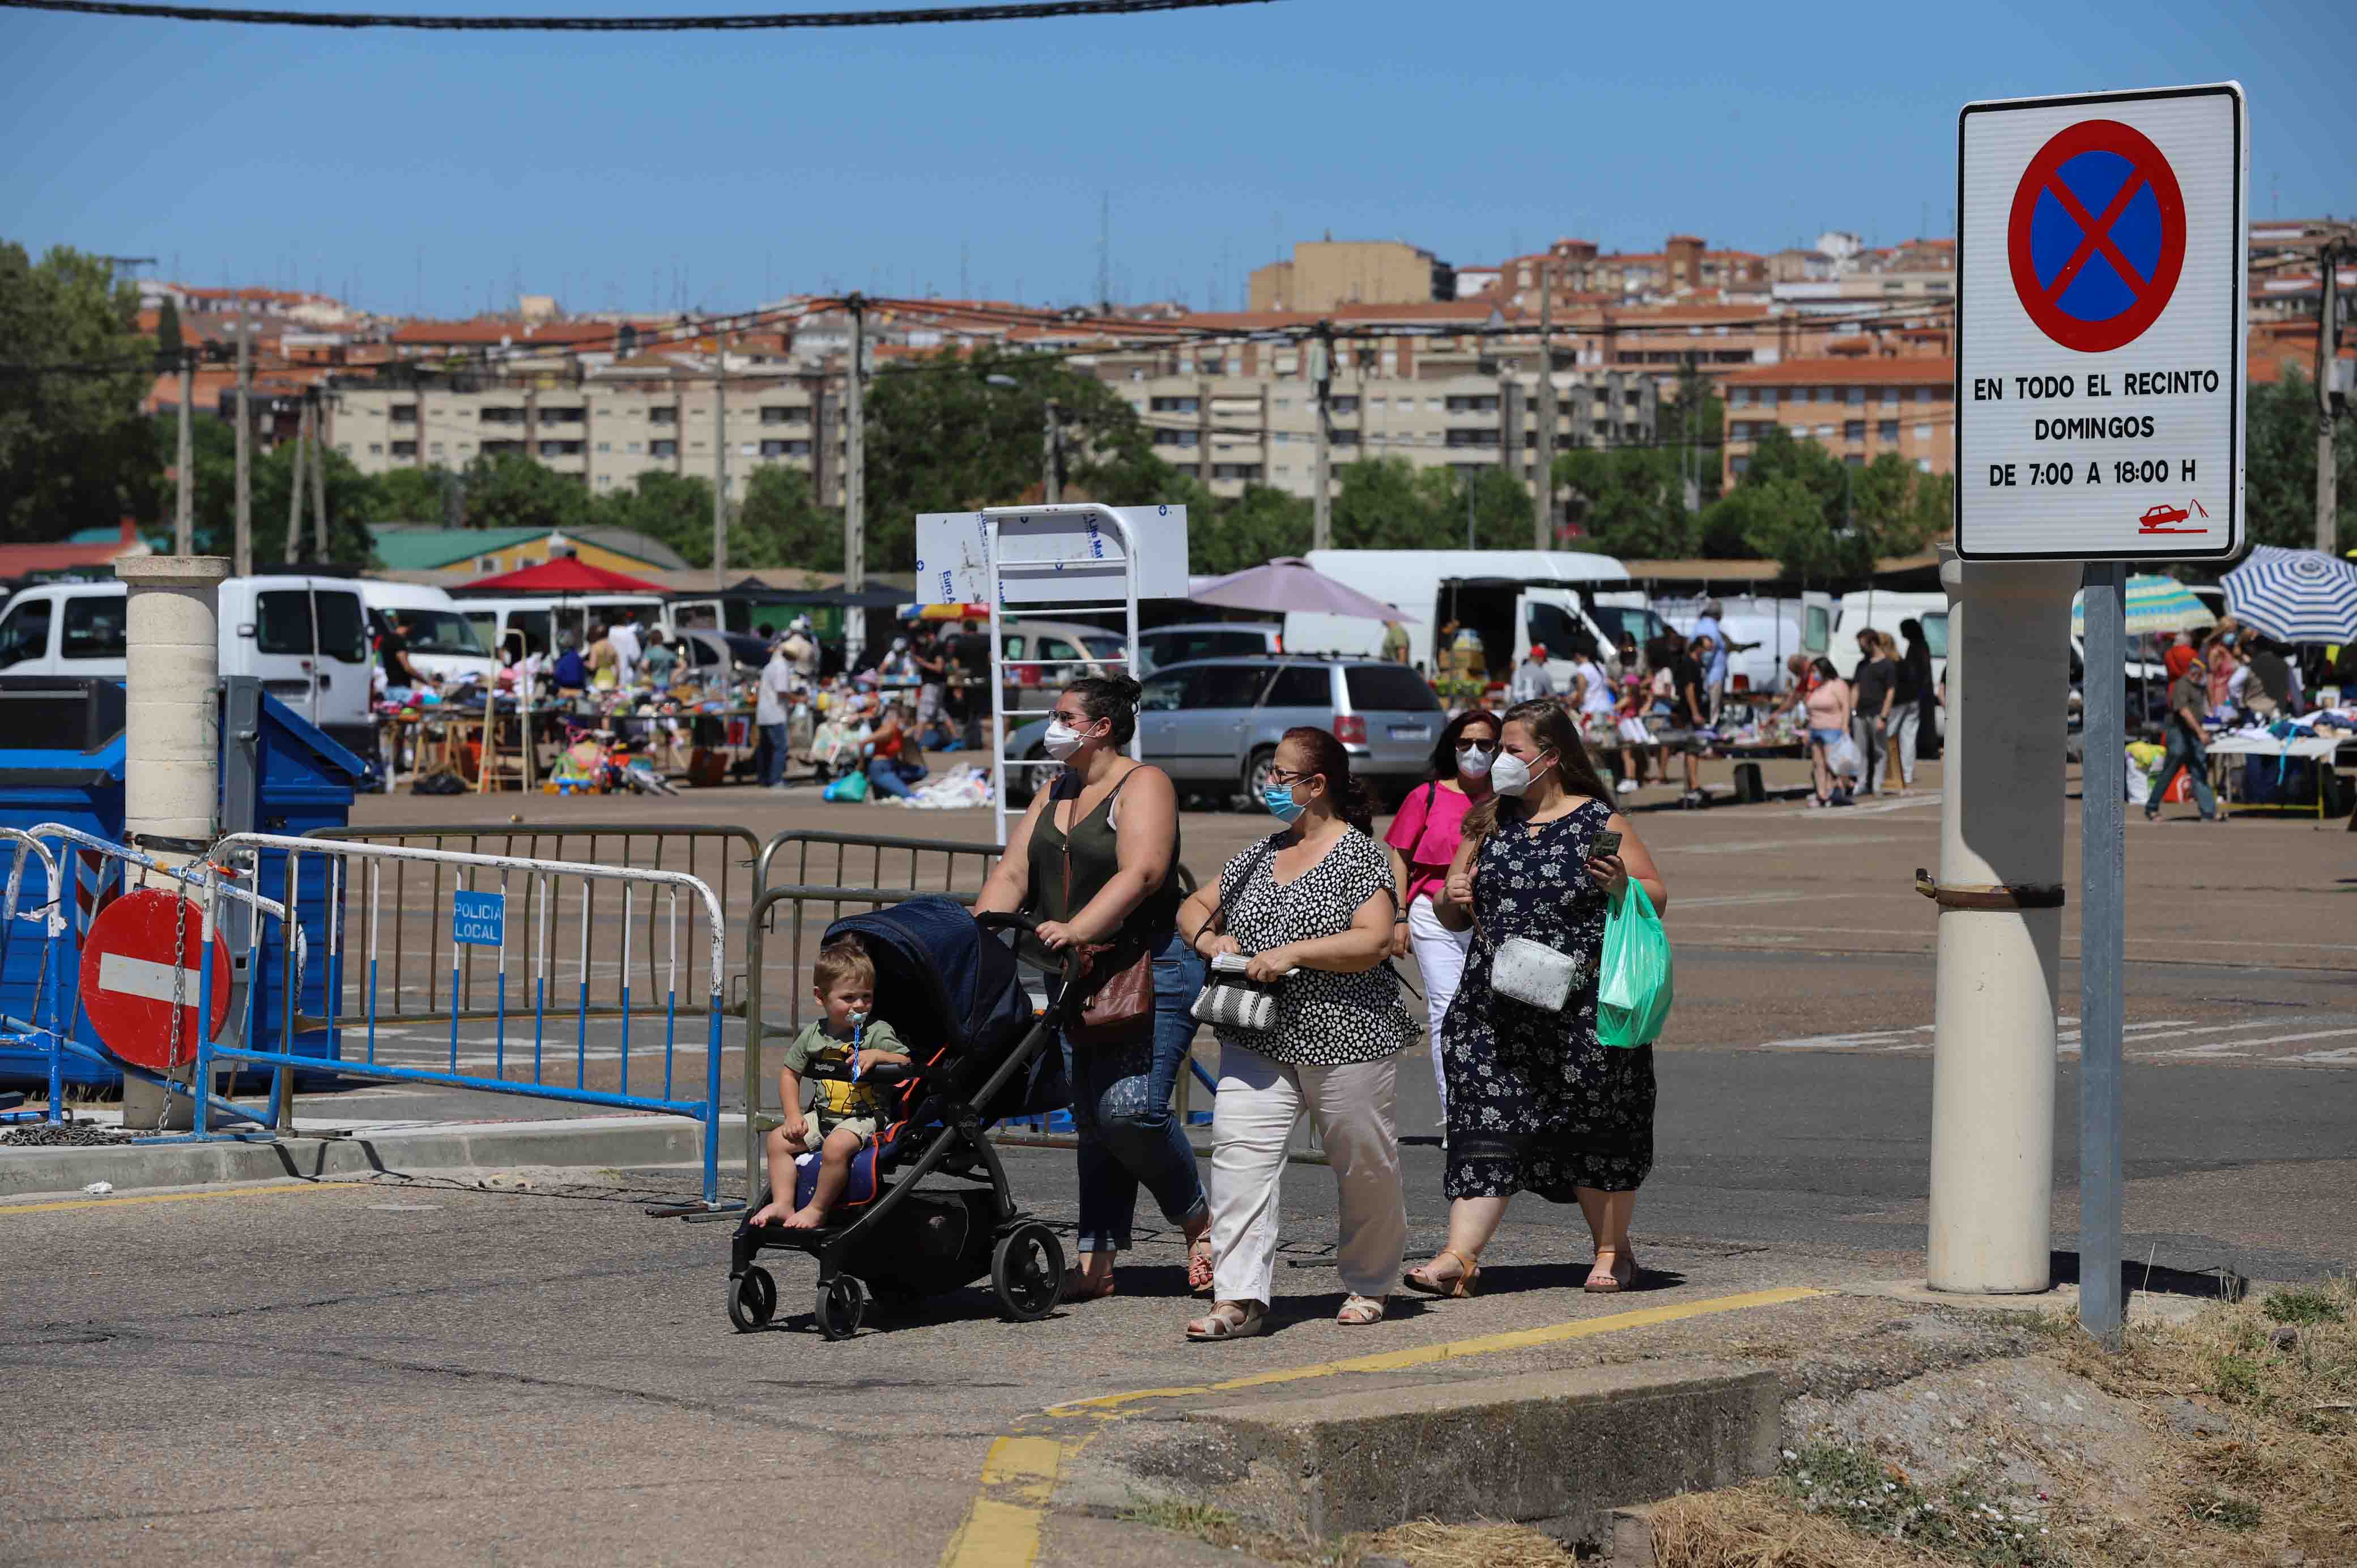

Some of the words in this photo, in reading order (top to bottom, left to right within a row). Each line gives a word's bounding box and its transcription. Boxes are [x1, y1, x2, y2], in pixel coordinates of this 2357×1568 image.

[1975, 378, 2002, 401] EN
[2015, 375, 2074, 399] TODO
[2087, 374, 2112, 397] EL
[2124, 369, 2219, 395] RECINTO
[2035, 415, 2155, 440] DOMINGOS
[1989, 464, 2016, 487] DE
[2029, 462, 2073, 485] 7:00
[2086, 462, 2101, 484] A
[2114, 459, 2169, 483] 18:00
[2182, 459, 2196, 482] H
[943, 570, 953, 595] Euro
[453, 902, 502, 921] POLICIA
[455, 922, 499, 940] LOCAL
